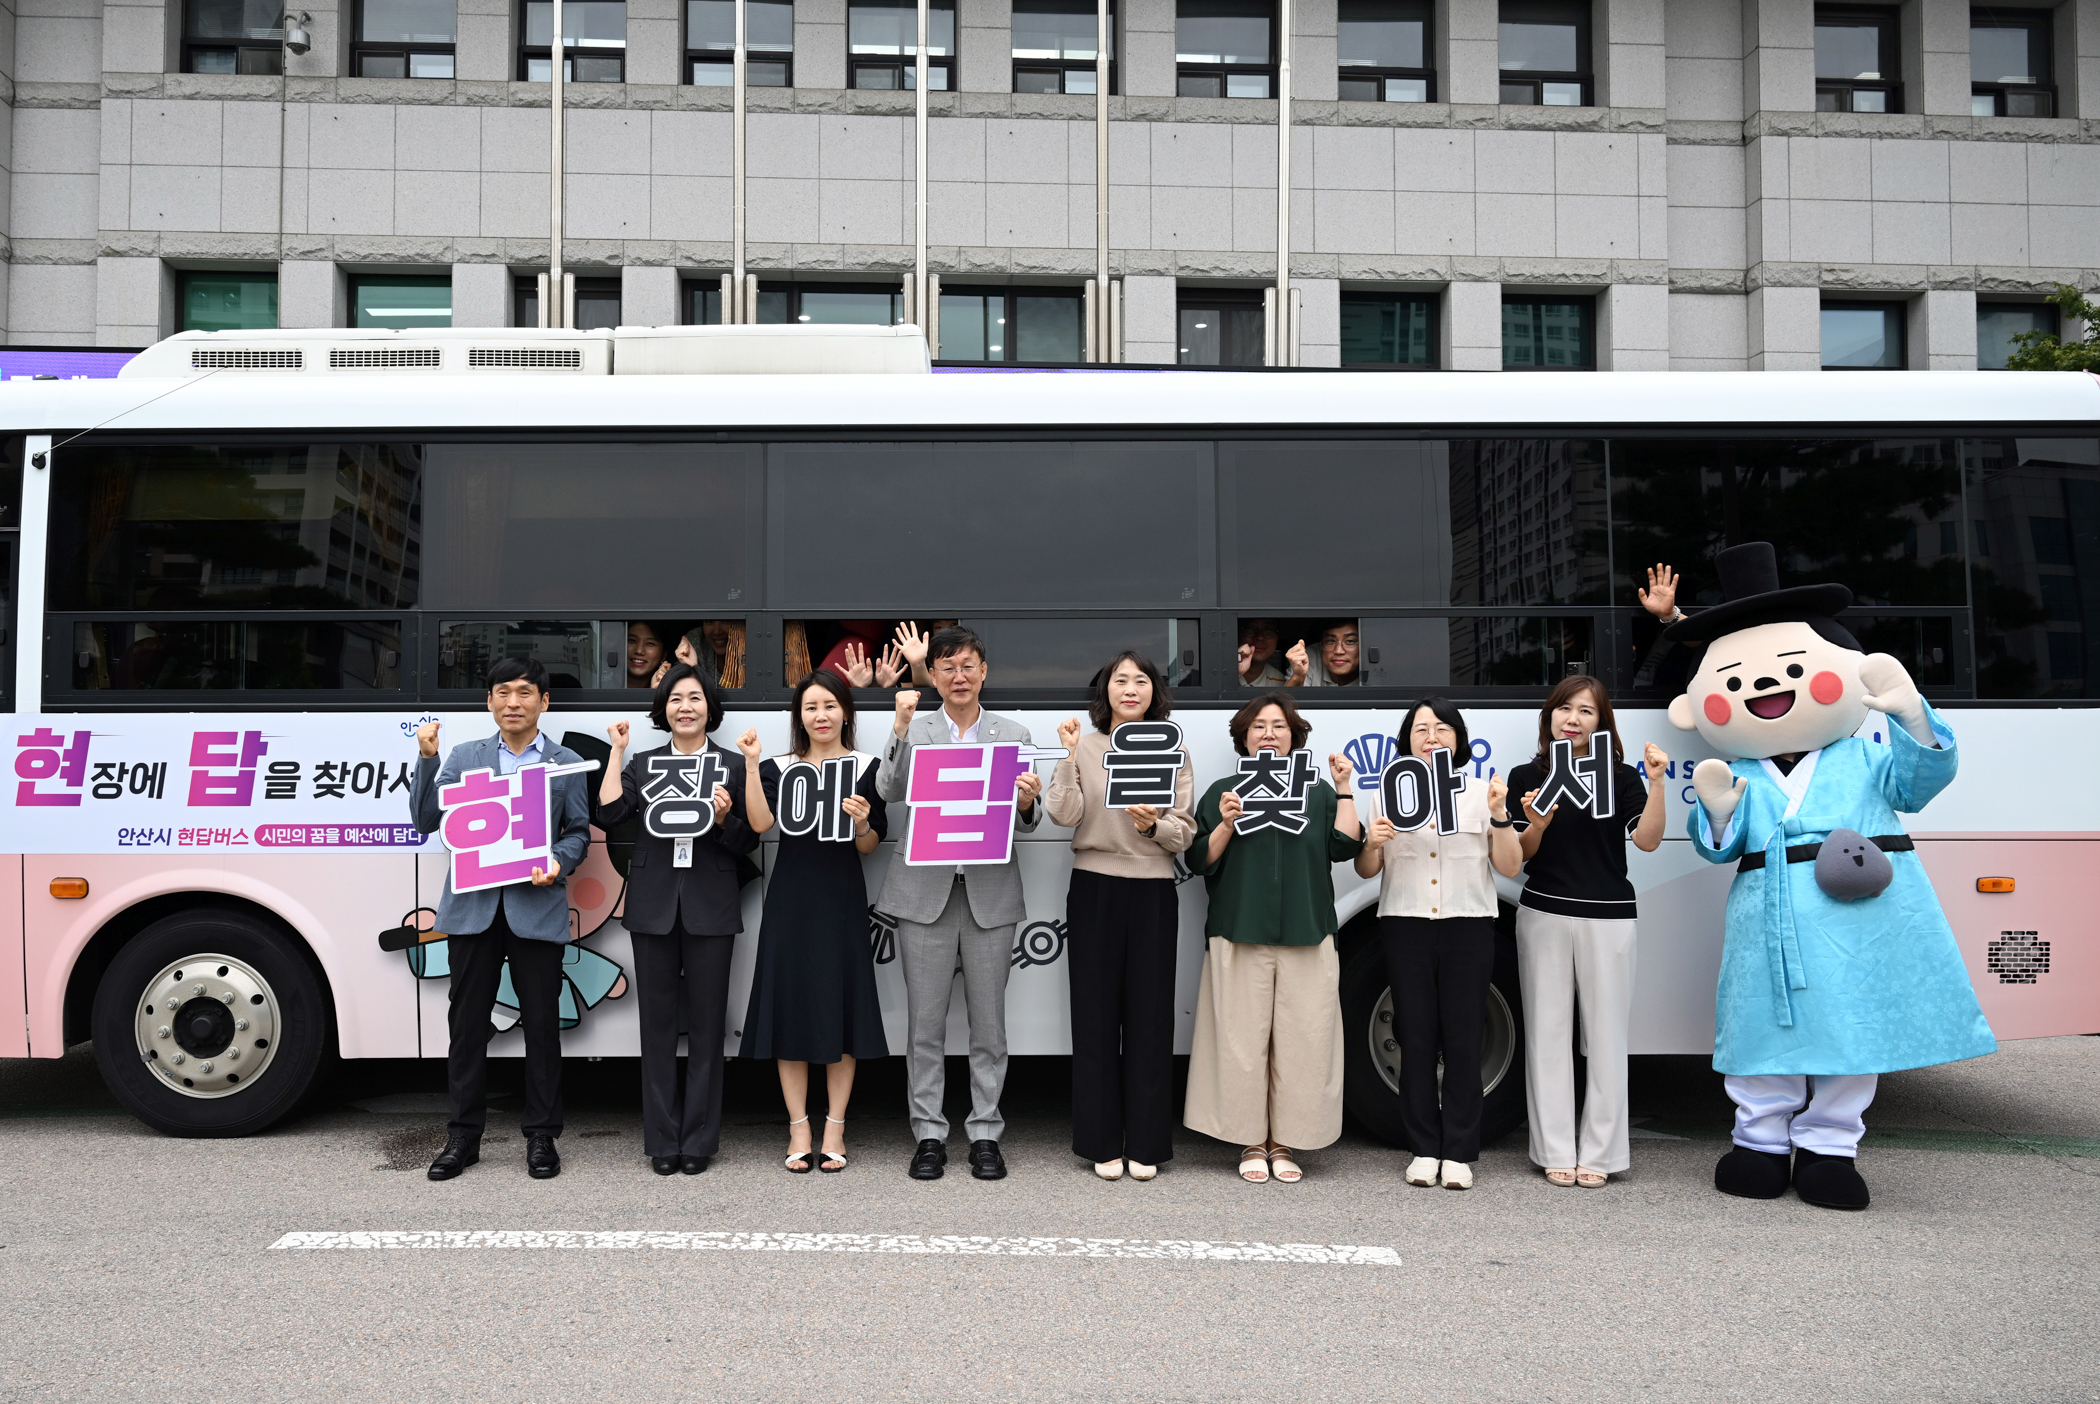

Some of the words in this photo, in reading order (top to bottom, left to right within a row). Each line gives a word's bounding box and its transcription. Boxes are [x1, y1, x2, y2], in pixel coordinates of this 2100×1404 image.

[14, 727, 168, 807] 현장에
[187, 730, 301, 807] 답을
[440, 764, 552, 892] 현
[643, 753, 729, 836] 장
[779, 758, 857, 841] 에
[907, 743, 1032, 864] 답
[1104, 721, 1184, 808] 을
[1233, 750, 1319, 835] 찾
[1381, 748, 1464, 834] 아
[1532, 732, 1614, 818] 서
[117, 827, 172, 846] 안산시
[177, 827, 249, 846] 현답버스
[261, 828, 306, 844] 시민의
[310, 828, 340, 844] 꿈을
[344, 828, 389, 844] 예산에
